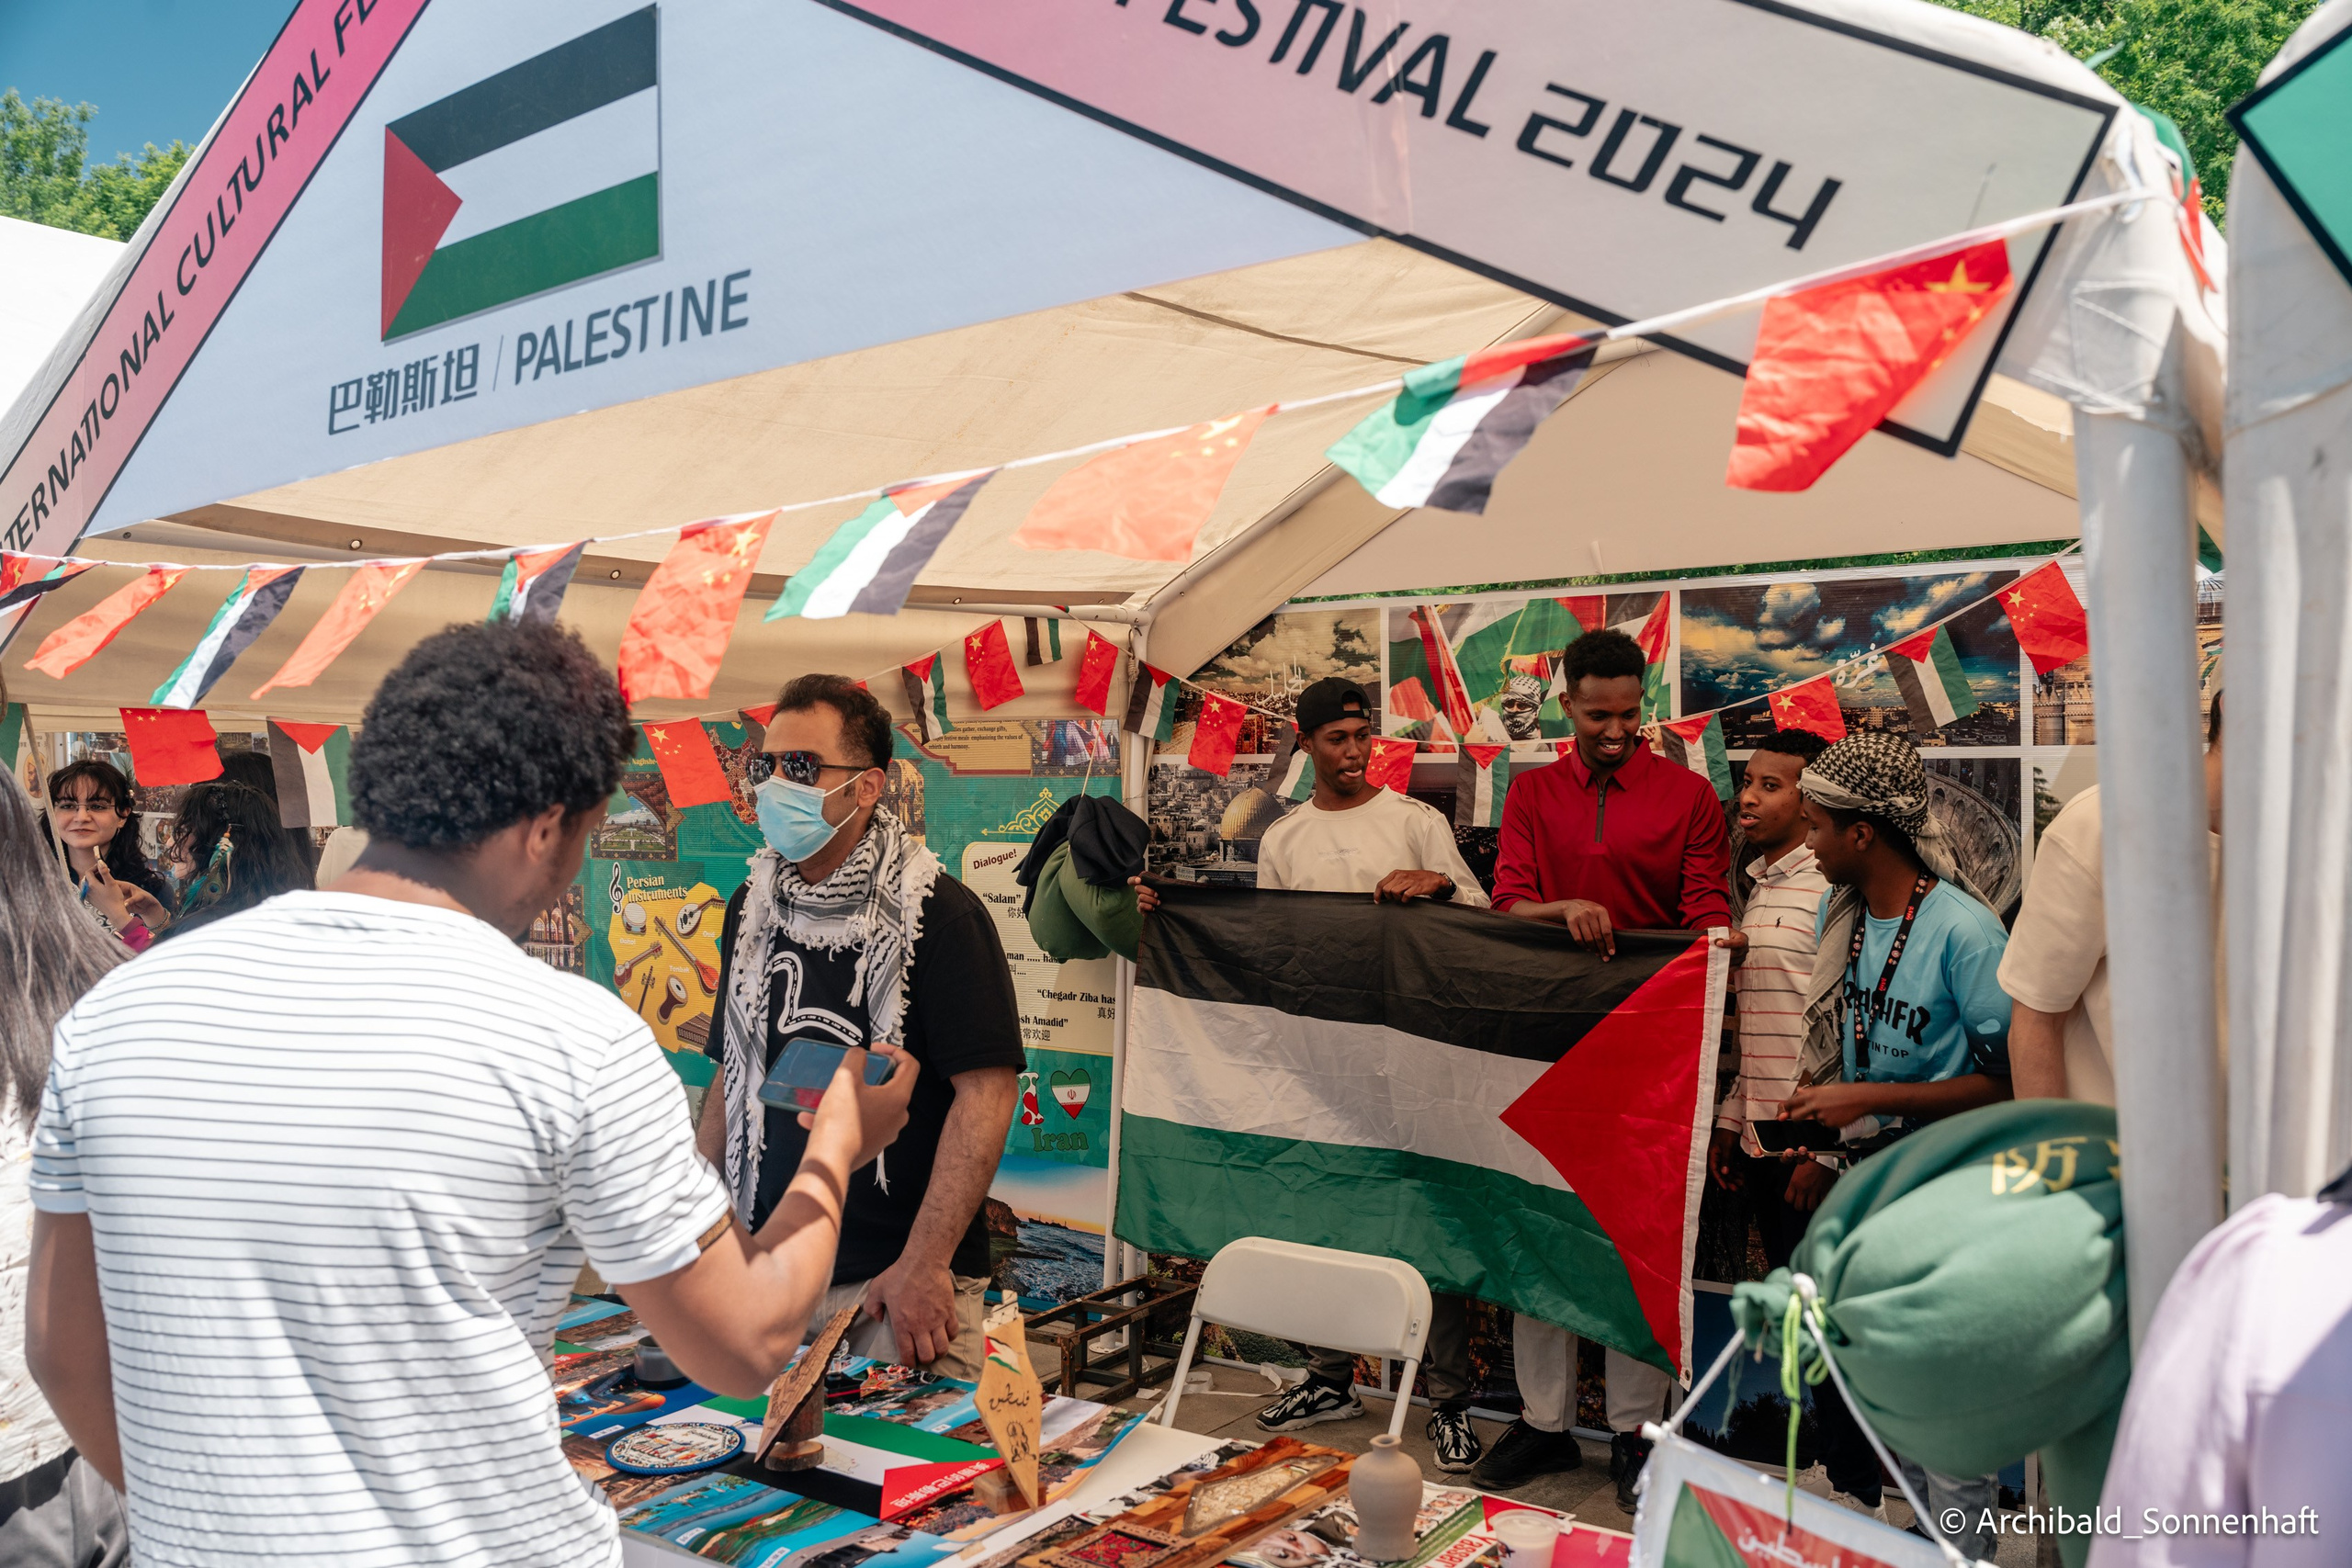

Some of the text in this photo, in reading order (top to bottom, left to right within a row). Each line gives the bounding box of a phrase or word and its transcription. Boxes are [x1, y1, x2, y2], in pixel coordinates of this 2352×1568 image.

[1517, 82, 1843, 252] 2024
[0, 290, 175, 552] TERNATIONAL
[175, 48, 331, 297] CULTURAL
[515, 269, 752, 386] PALESTINE
[328, 343, 480, 435] 巴勒斯坦
[973, 849, 1017, 870] Dialogue!
[627, 874, 664, 889] Persian
[628, 886, 688, 903] Instruments
[1080, 992, 1099, 1003] Ziba
[1031, 1127, 1089, 1152] Iran
